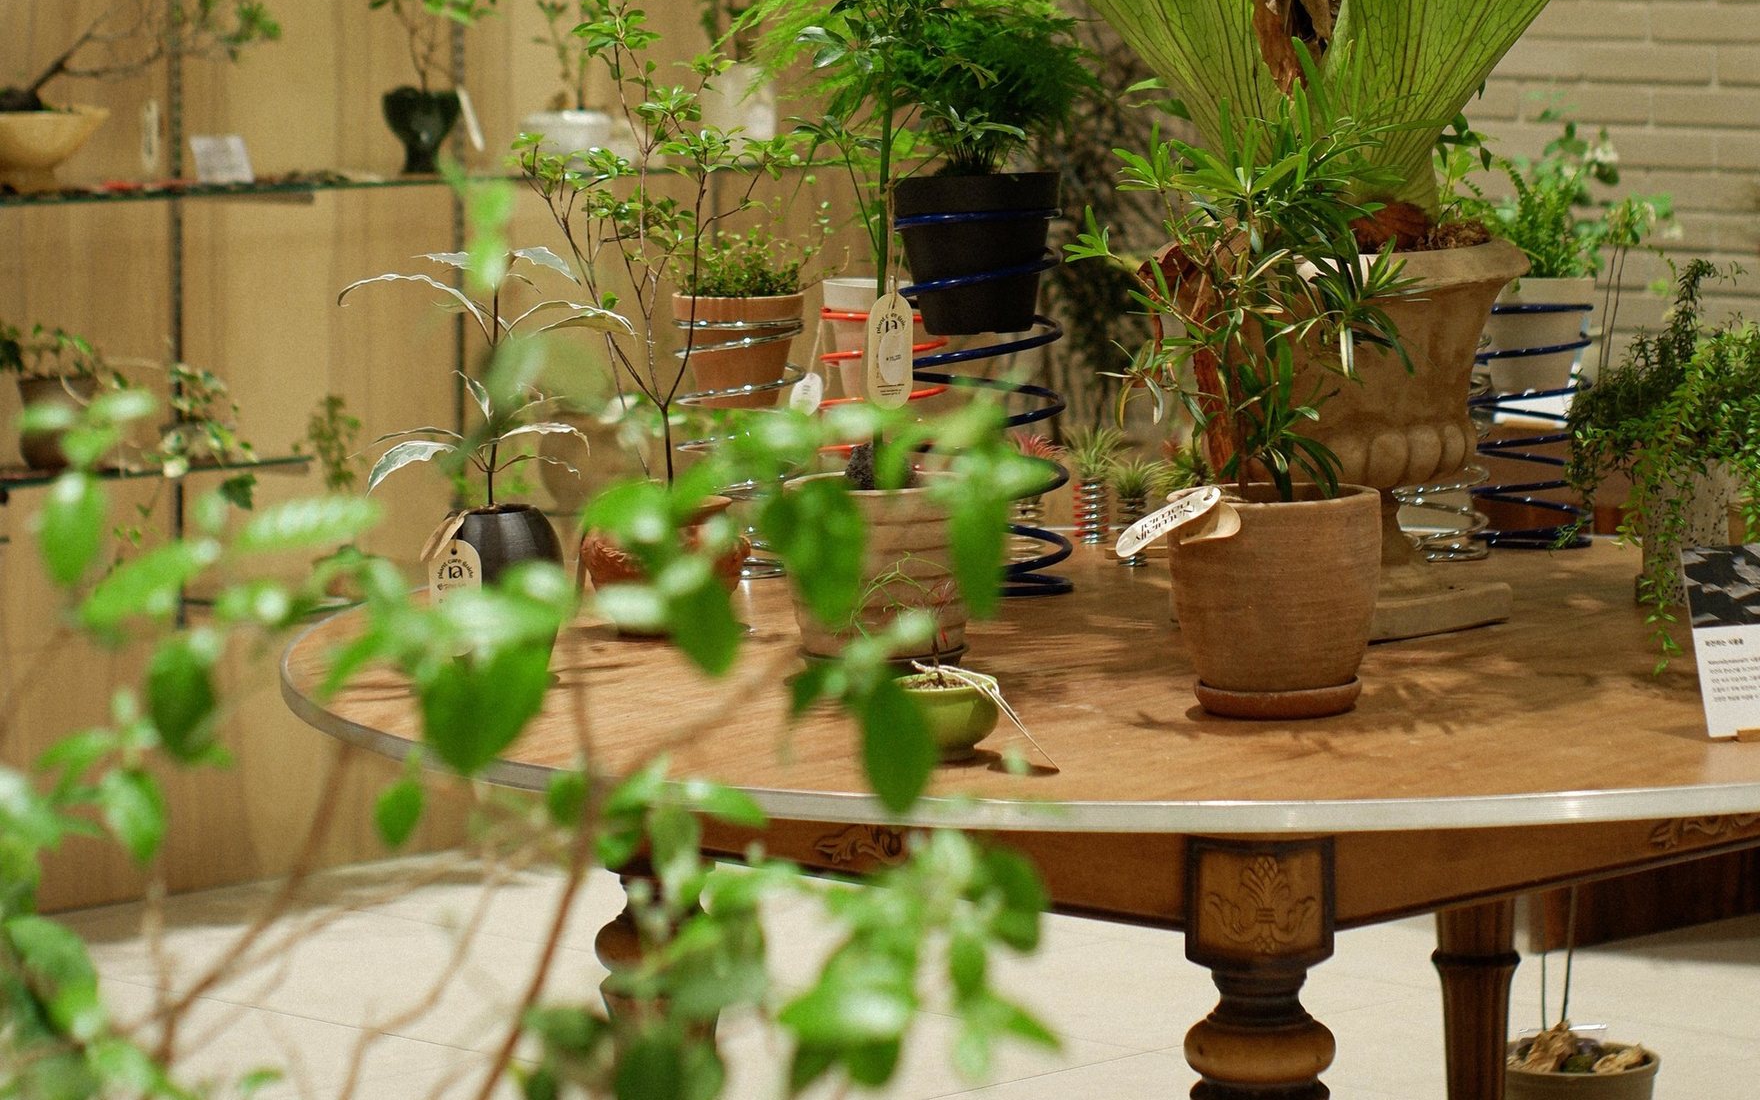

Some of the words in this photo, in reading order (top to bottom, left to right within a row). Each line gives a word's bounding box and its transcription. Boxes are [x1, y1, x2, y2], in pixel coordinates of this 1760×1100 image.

[1132, 505, 1194, 545] Naturally
[1141, 500, 1190, 533] natural
[437, 561, 448, 580] plant
